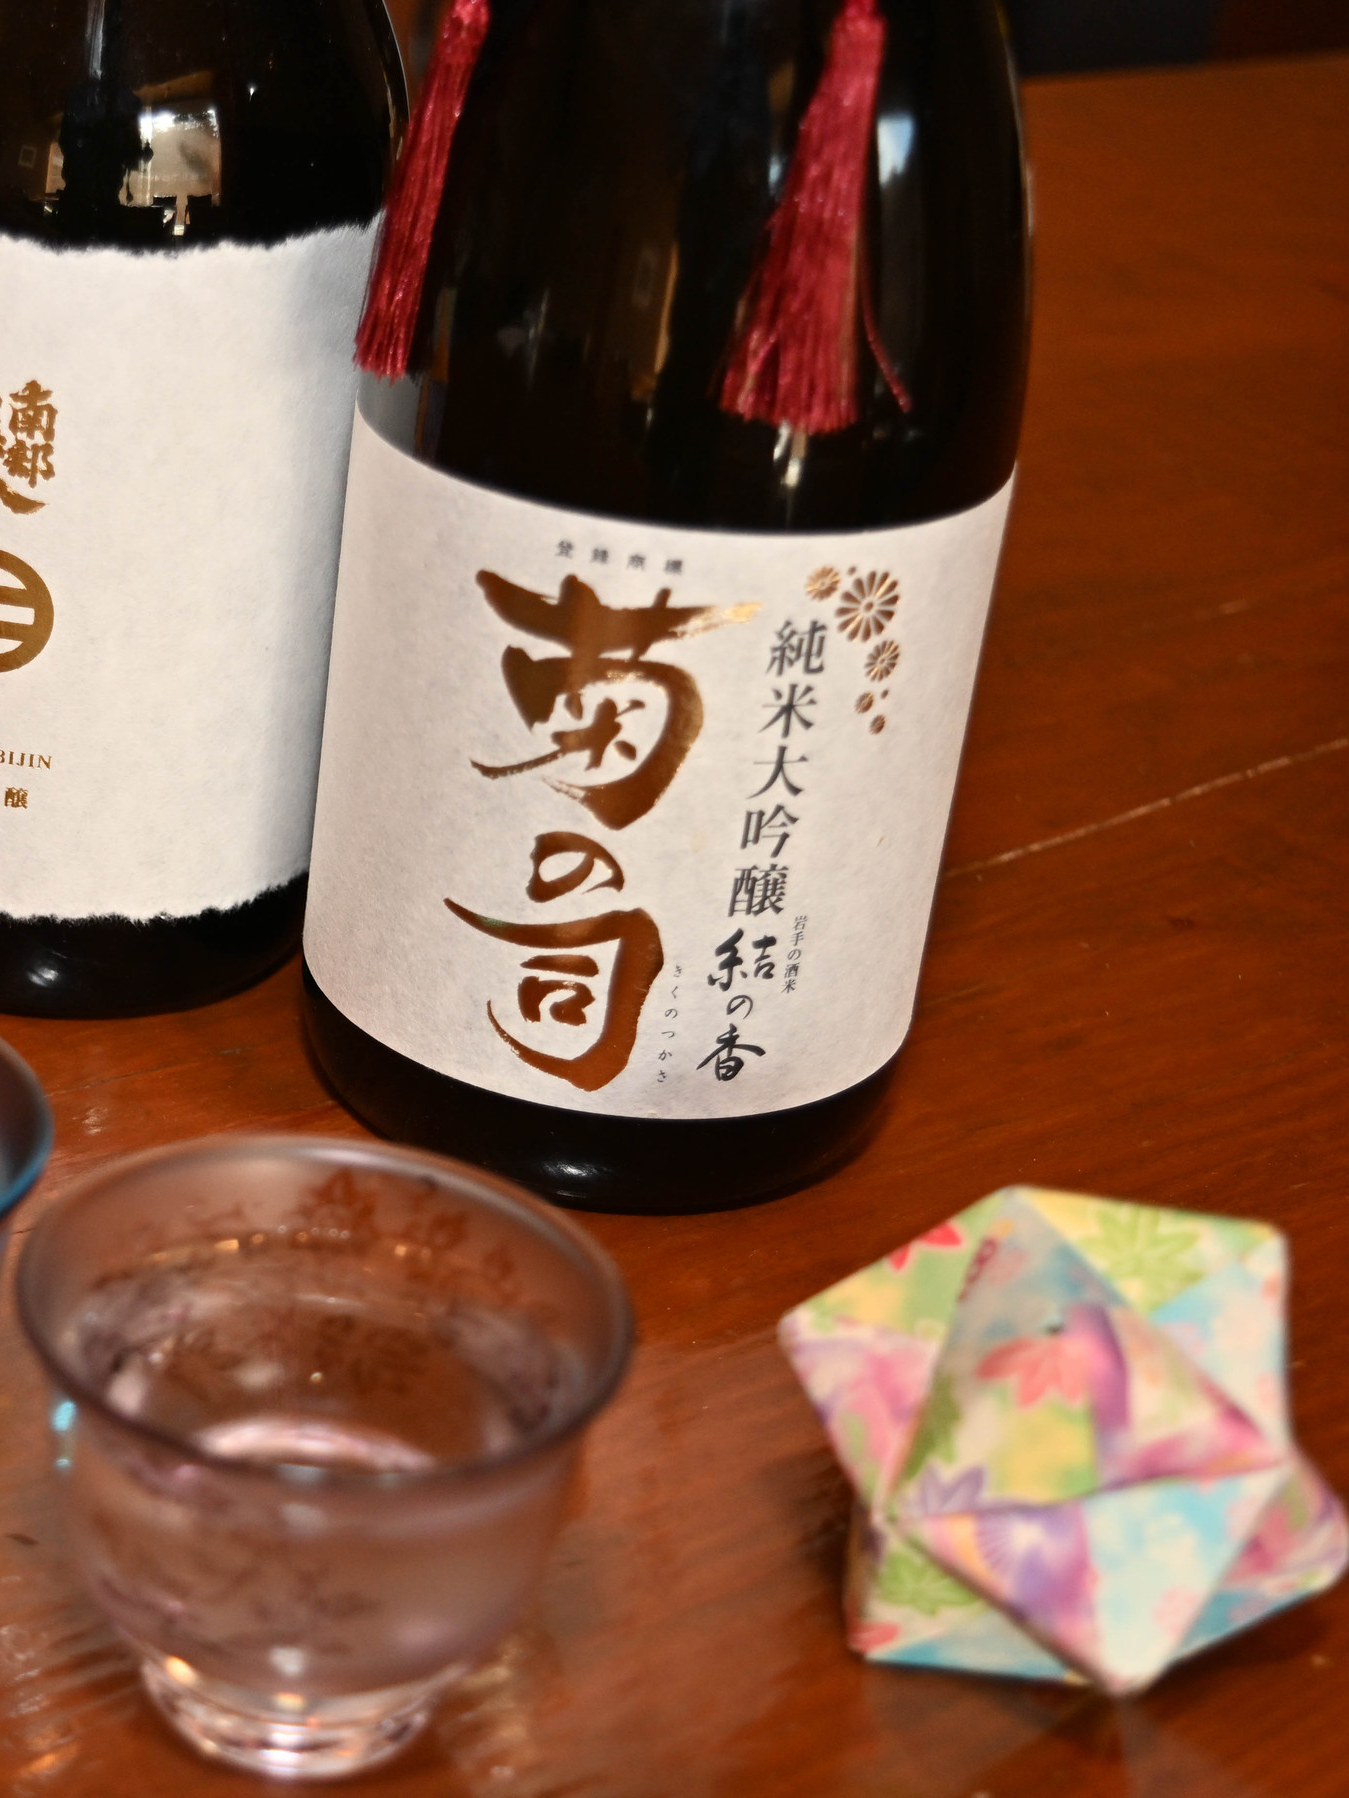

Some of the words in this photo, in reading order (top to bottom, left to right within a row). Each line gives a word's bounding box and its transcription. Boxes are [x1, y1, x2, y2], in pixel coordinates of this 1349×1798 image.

[444, 568, 762, 1092] 菊の司
[725, 620, 828, 918] 純米大吟醸
[656, 964, 683, 1084] きくのつかさ
[696, 928, 778, 1082] 結の香
[781, 915, 808, 995] 岩手の酒米
